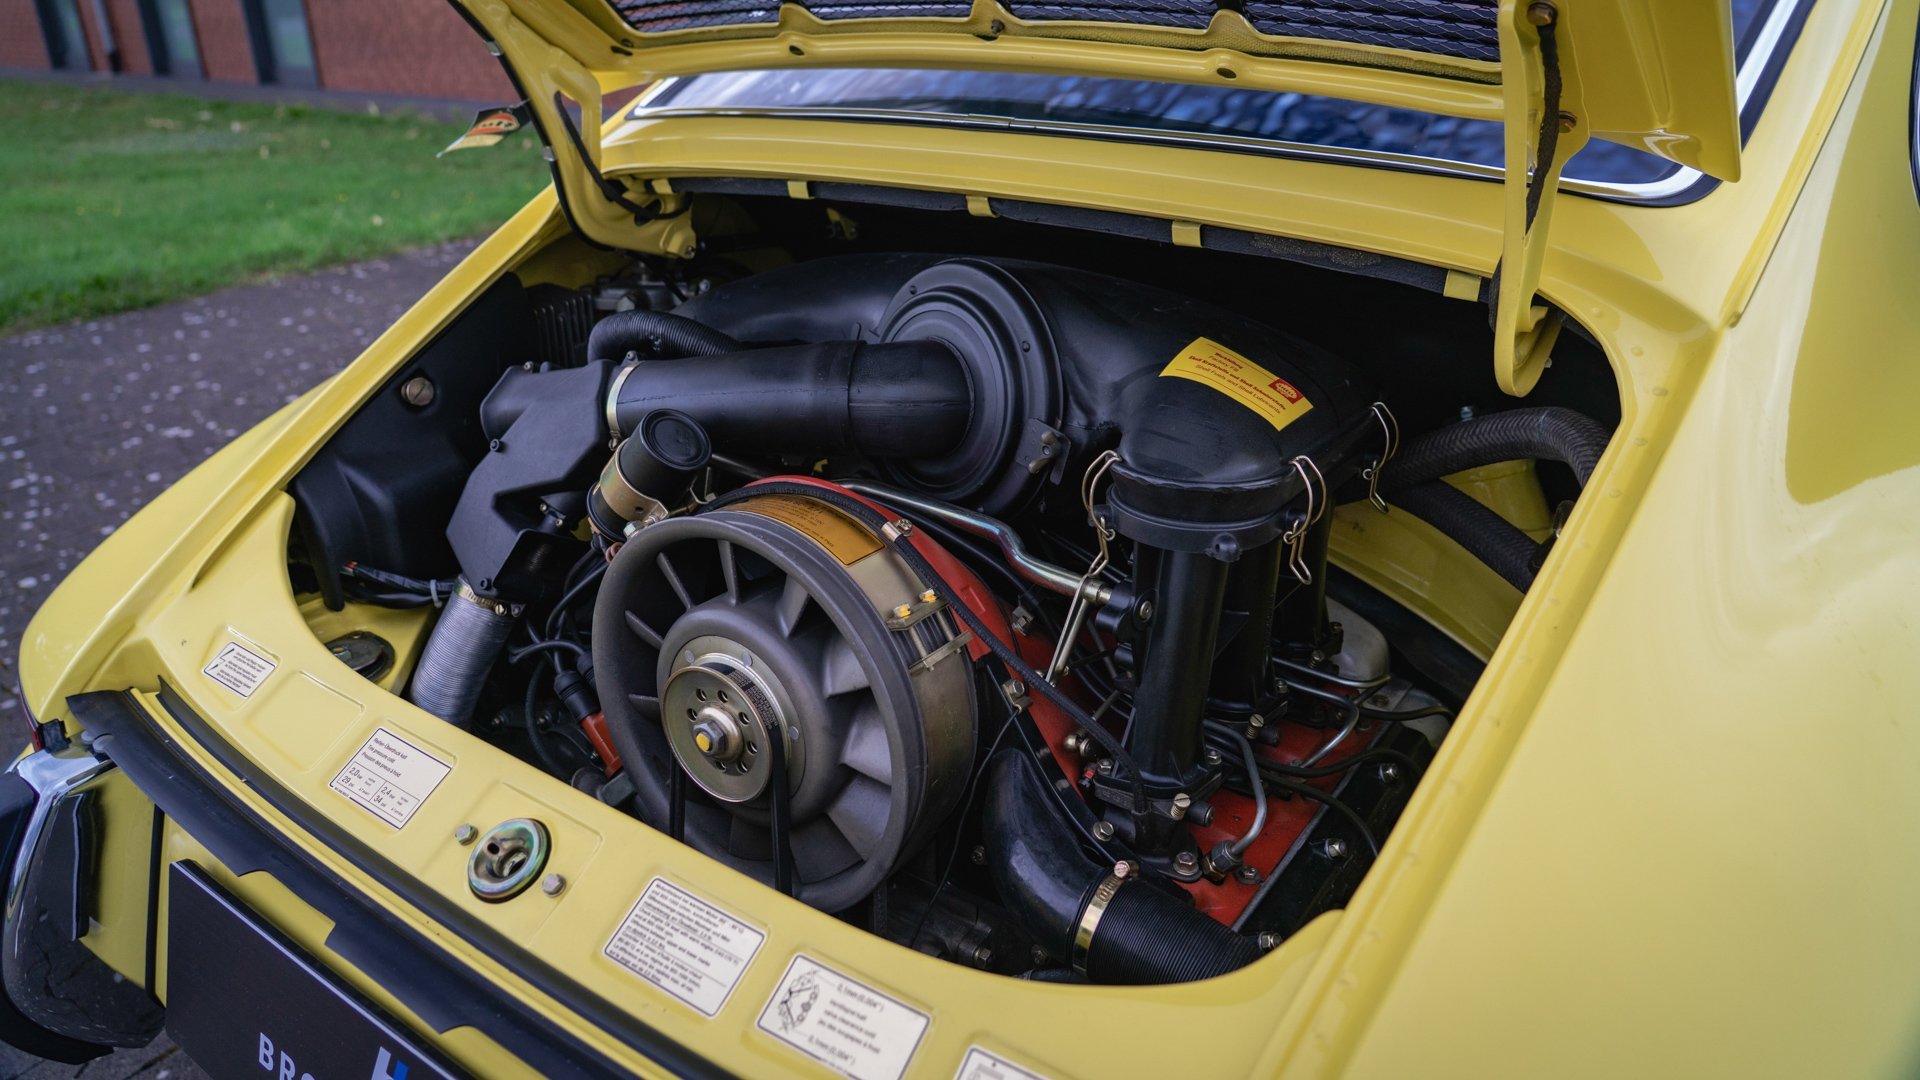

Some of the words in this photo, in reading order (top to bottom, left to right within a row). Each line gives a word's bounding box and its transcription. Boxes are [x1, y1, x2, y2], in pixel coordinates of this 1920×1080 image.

[349, 767, 360, 776] 2,0
[341, 775, 351, 783] 29
[380, 786, 391, 795] 2,4
[373, 795, 383, 803] 34
[258, 1032, 315, 1080] BR
